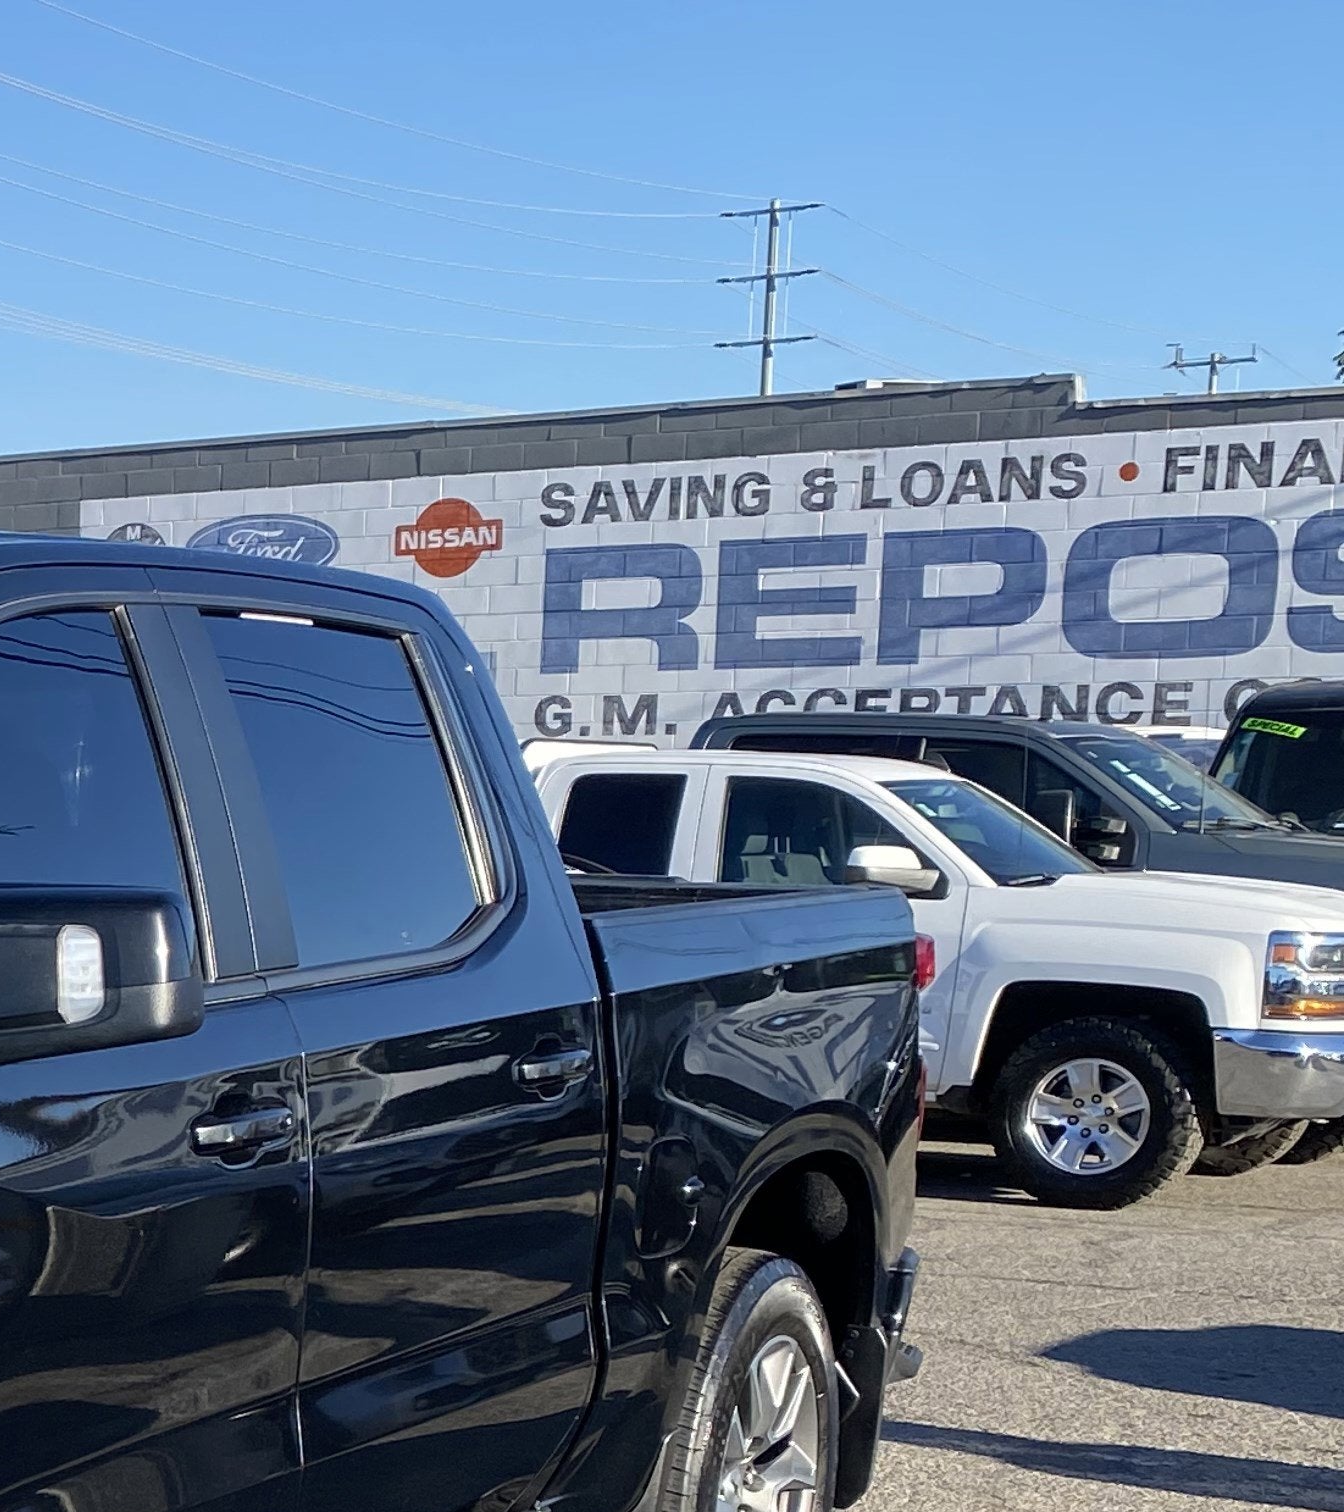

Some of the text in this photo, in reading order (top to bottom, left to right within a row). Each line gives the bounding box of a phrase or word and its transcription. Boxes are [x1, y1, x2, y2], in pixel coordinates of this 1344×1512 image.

[539, 438, 1344, 528] SAVING & LOANS FINA
[400, 525, 497, 550] NISSAN
[539, 507, 1344, 675] REPO
[534, 694, 678, 738] G.M.
[1247, 719, 1299, 736] SPECIAL
